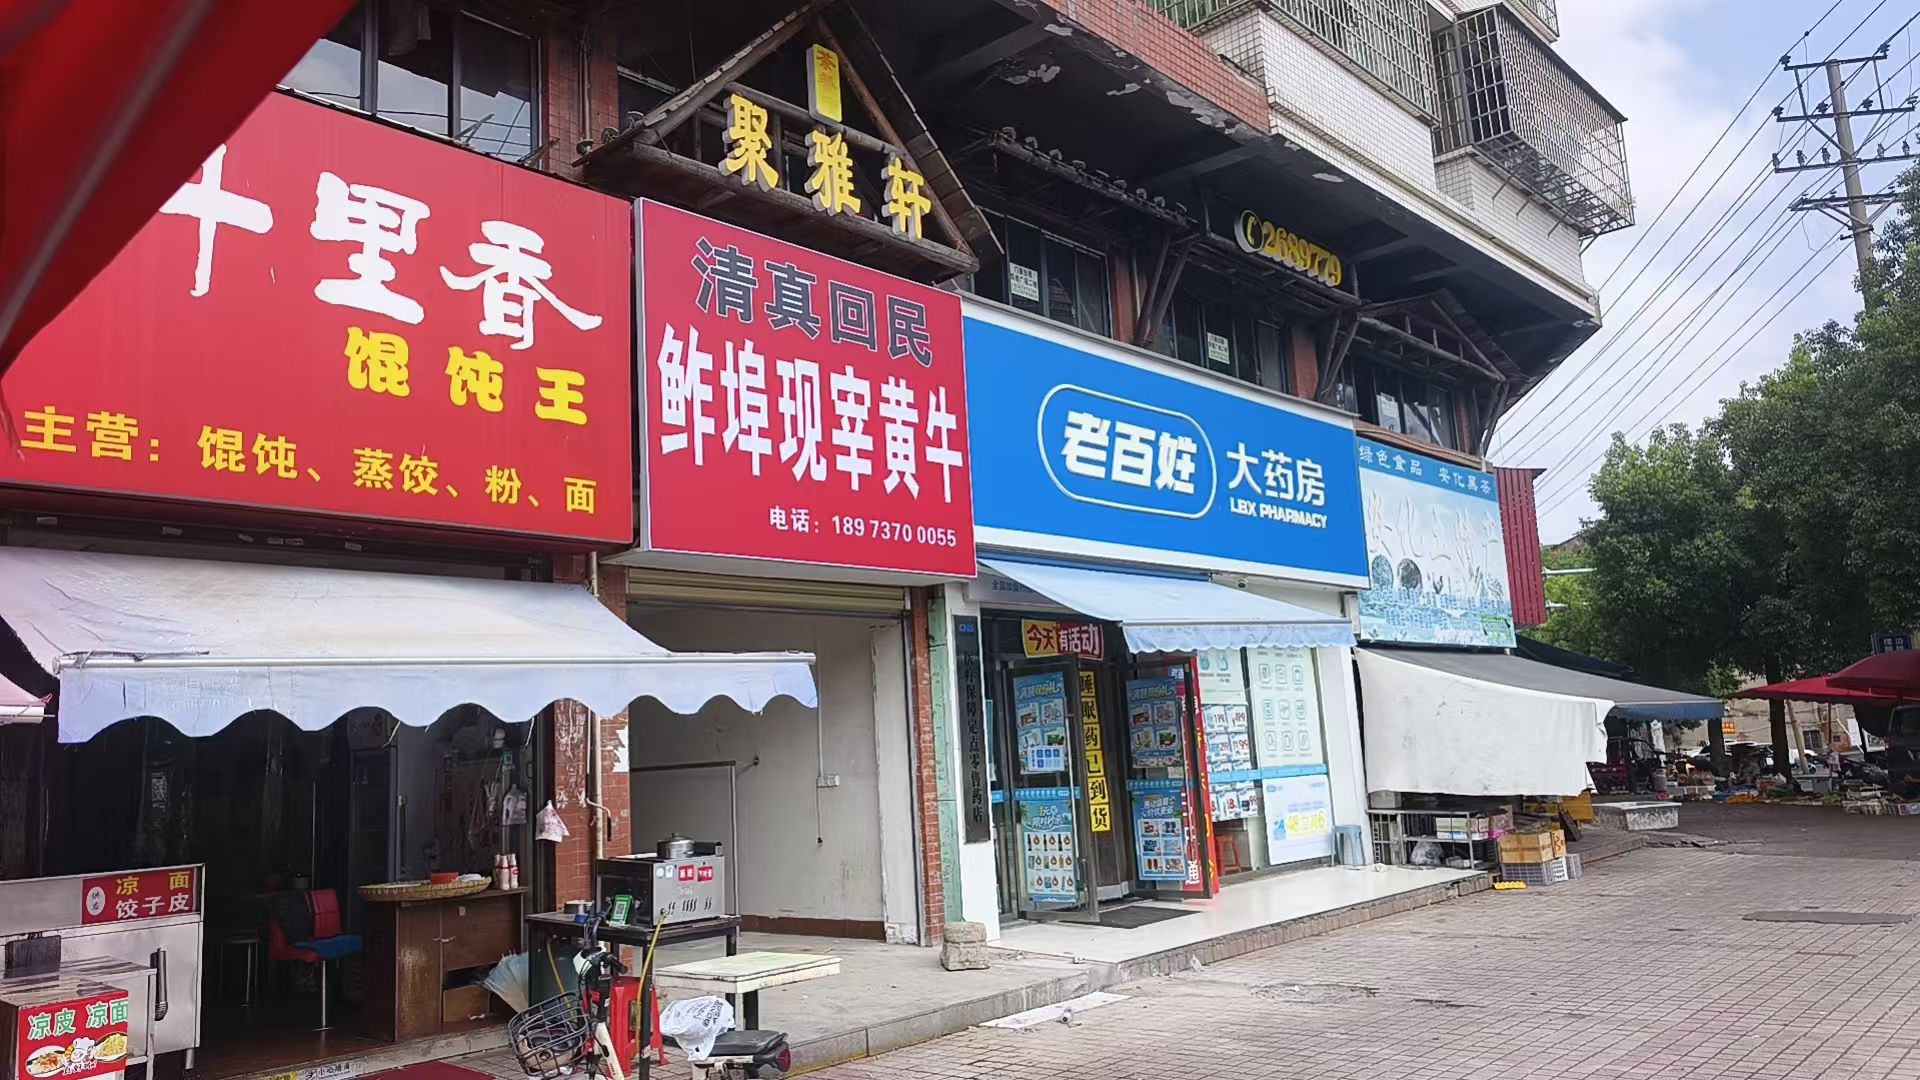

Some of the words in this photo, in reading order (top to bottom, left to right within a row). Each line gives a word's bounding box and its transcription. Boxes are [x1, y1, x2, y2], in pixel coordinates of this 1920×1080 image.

[726, 93, 932, 240] 聚雅轩
[1263, 220, 1342, 287] 2689779
[691, 236, 932, 368] 清真回民
[343, 325, 589, 426] 馄饨王
[656, 322, 964, 504] 鲊埠现宰黄牛
[1061, 410, 1198, 494] 老百姓
[1226, 441, 1325, 506] 大药房
[1358, 444, 1422, 477] 绿色食品
[869, 519, 912, 543] 7370
[916, 524, 956, 547] 0055
[1229, 495, 1257, 517] LBX
[1259, 503, 1327, 528] PHARMACY
[1026, 623, 1100, 656] 今天有活动
[1080, 674, 1108, 830] 睡眠药已到货
[115, 892, 191, 919] 饺子皮
[27, 1008, 76, 1041] 凉皮
[85, 998, 128, 1028] 凉面
